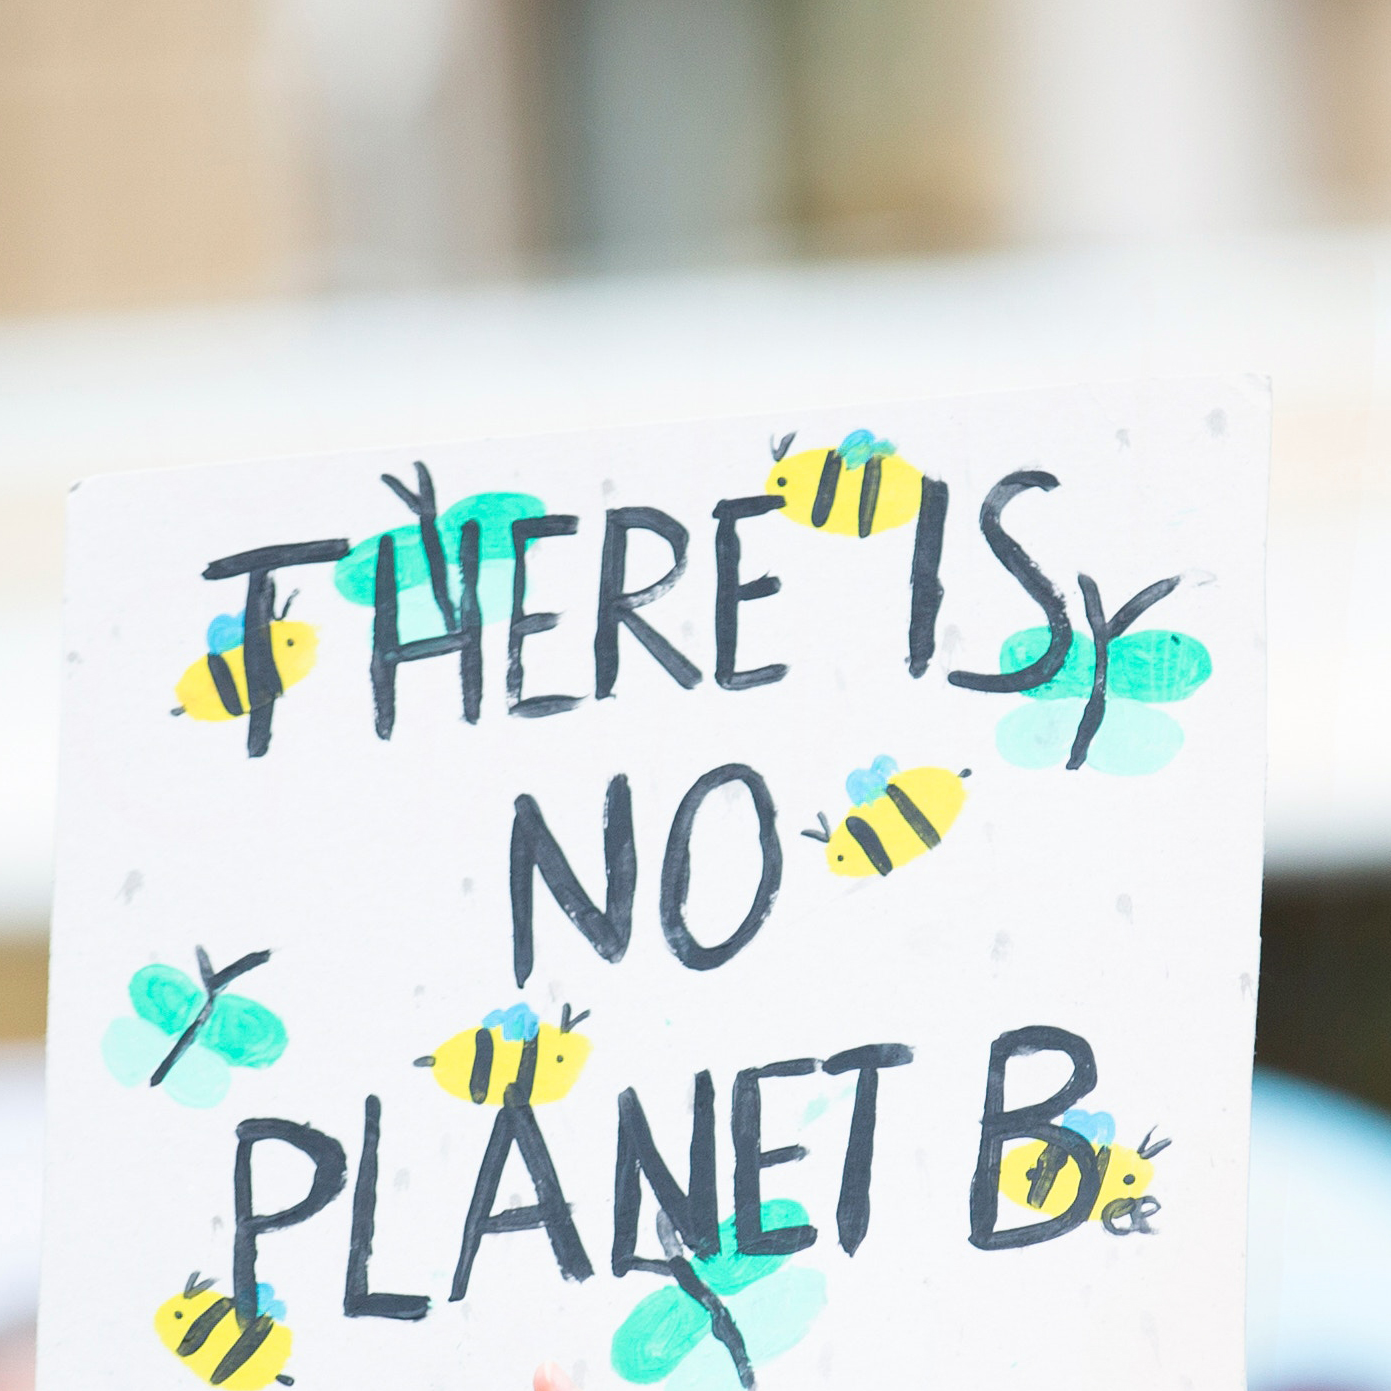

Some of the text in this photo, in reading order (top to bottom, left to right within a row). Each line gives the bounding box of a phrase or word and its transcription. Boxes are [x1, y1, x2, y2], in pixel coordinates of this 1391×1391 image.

[202, 468, 1076, 759] THERE IS
[508, 761, 783, 990] NO
[232, 1042, 915, 1327] PLANET
